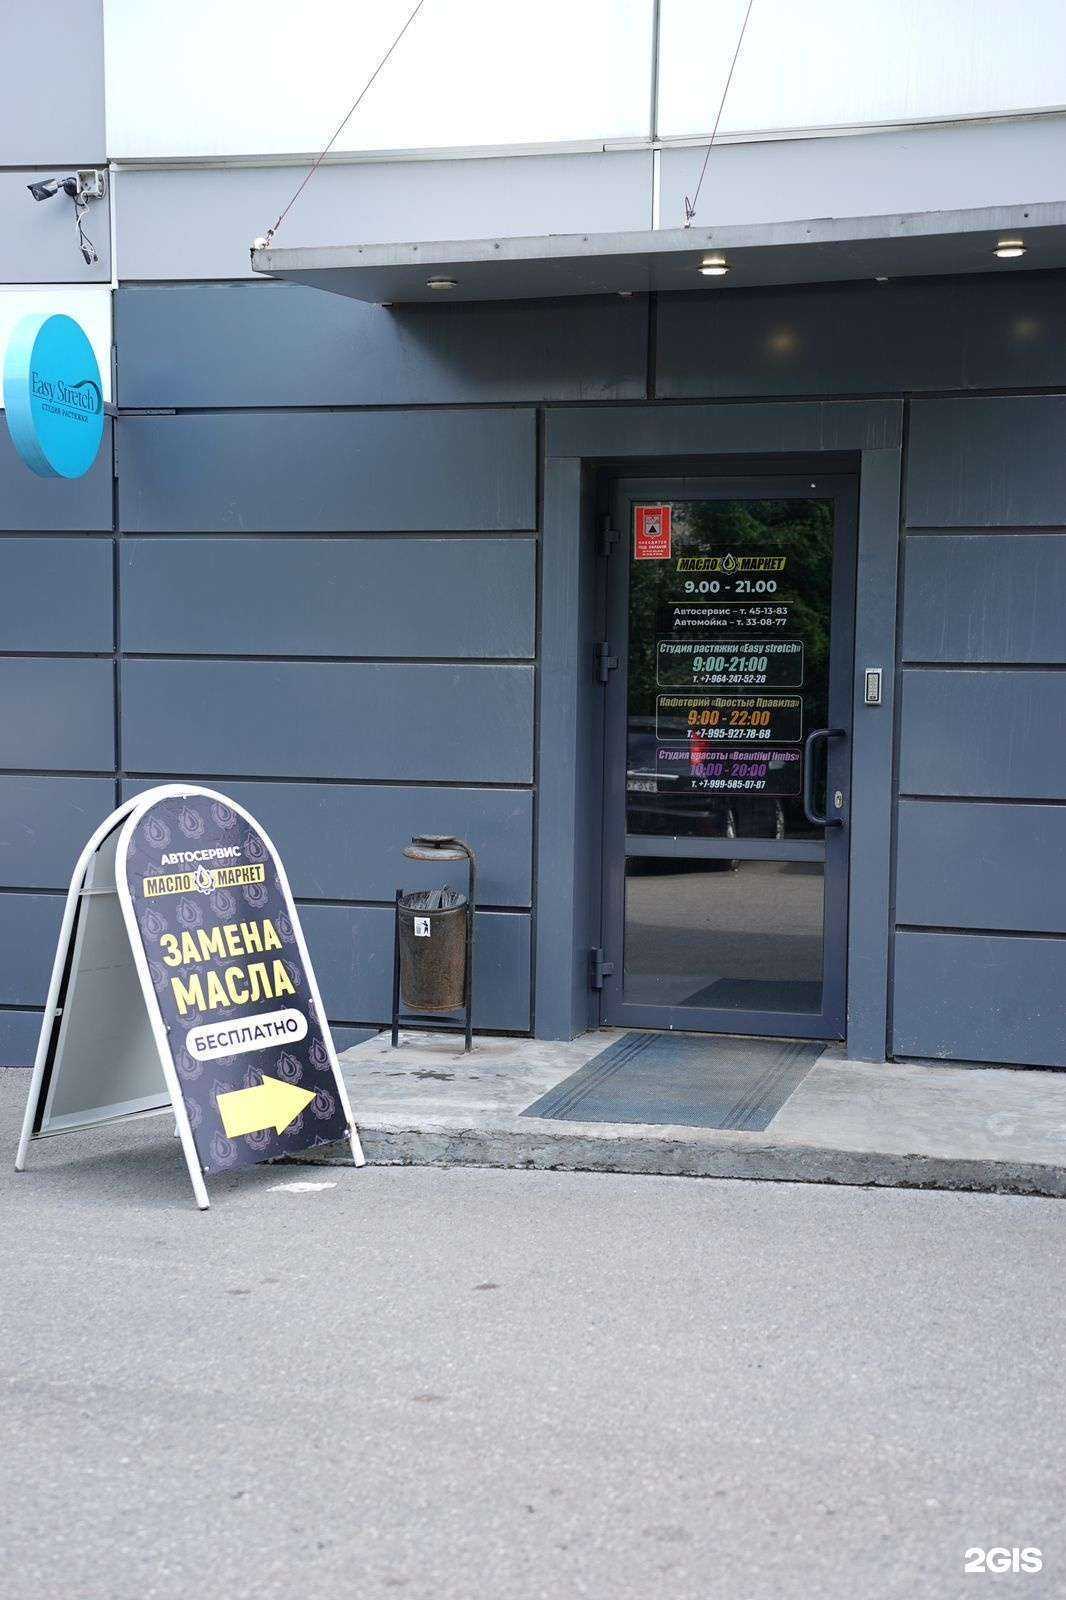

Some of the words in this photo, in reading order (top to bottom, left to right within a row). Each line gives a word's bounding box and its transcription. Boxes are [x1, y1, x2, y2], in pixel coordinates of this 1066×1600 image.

[32, 371, 55, 400] Easy
[57, 380, 94, 411] Stretch
[680, 558, 718, 571] МАСЛО
[740, 557, 784, 570] МАРКЕТ
[684, 581, 720, 593] 9.00
[735, 580, 777, 593] 21.00
[673, 607, 731, 616] Автосервис
[749, 607, 788, 615] 45-13-83
[674, 618, 728, 626] Автомойка
[746, 618, 787, 626] 33-08-77
[660, 643, 692, 654] Студия
[693, 644, 739, 654] растяжки
[740, 643, 763, 654] «Easy
[765, 643, 801, 653] stretch»
[692, 656, 768, 672] 9:00-21:00
[700, 674, 767, 683] +7-964-247-52-28
[660, 697, 712, 708] Кафетерий
[687, 710, 720, 726] 9:00
[729, 710, 771, 726] 22:00
[695, 728, 771, 739] +7-995-927-78-68
[659, 750, 690, 760] Студия
[690, 751, 729, 761] красоты
[730, 763, 768, 777] 20:00
[160, 846, 241, 866] АВТОСЕРВИС
[146, 874, 191, 895] МАСЛО
[217, 865, 262, 885] МАРКЕТ
[159, 918, 283, 967] ЗАМЕНА
[170, 959, 296, 1016] МАСЛА
[194, 1018, 299, 1052] БЕСПЛАТНО
